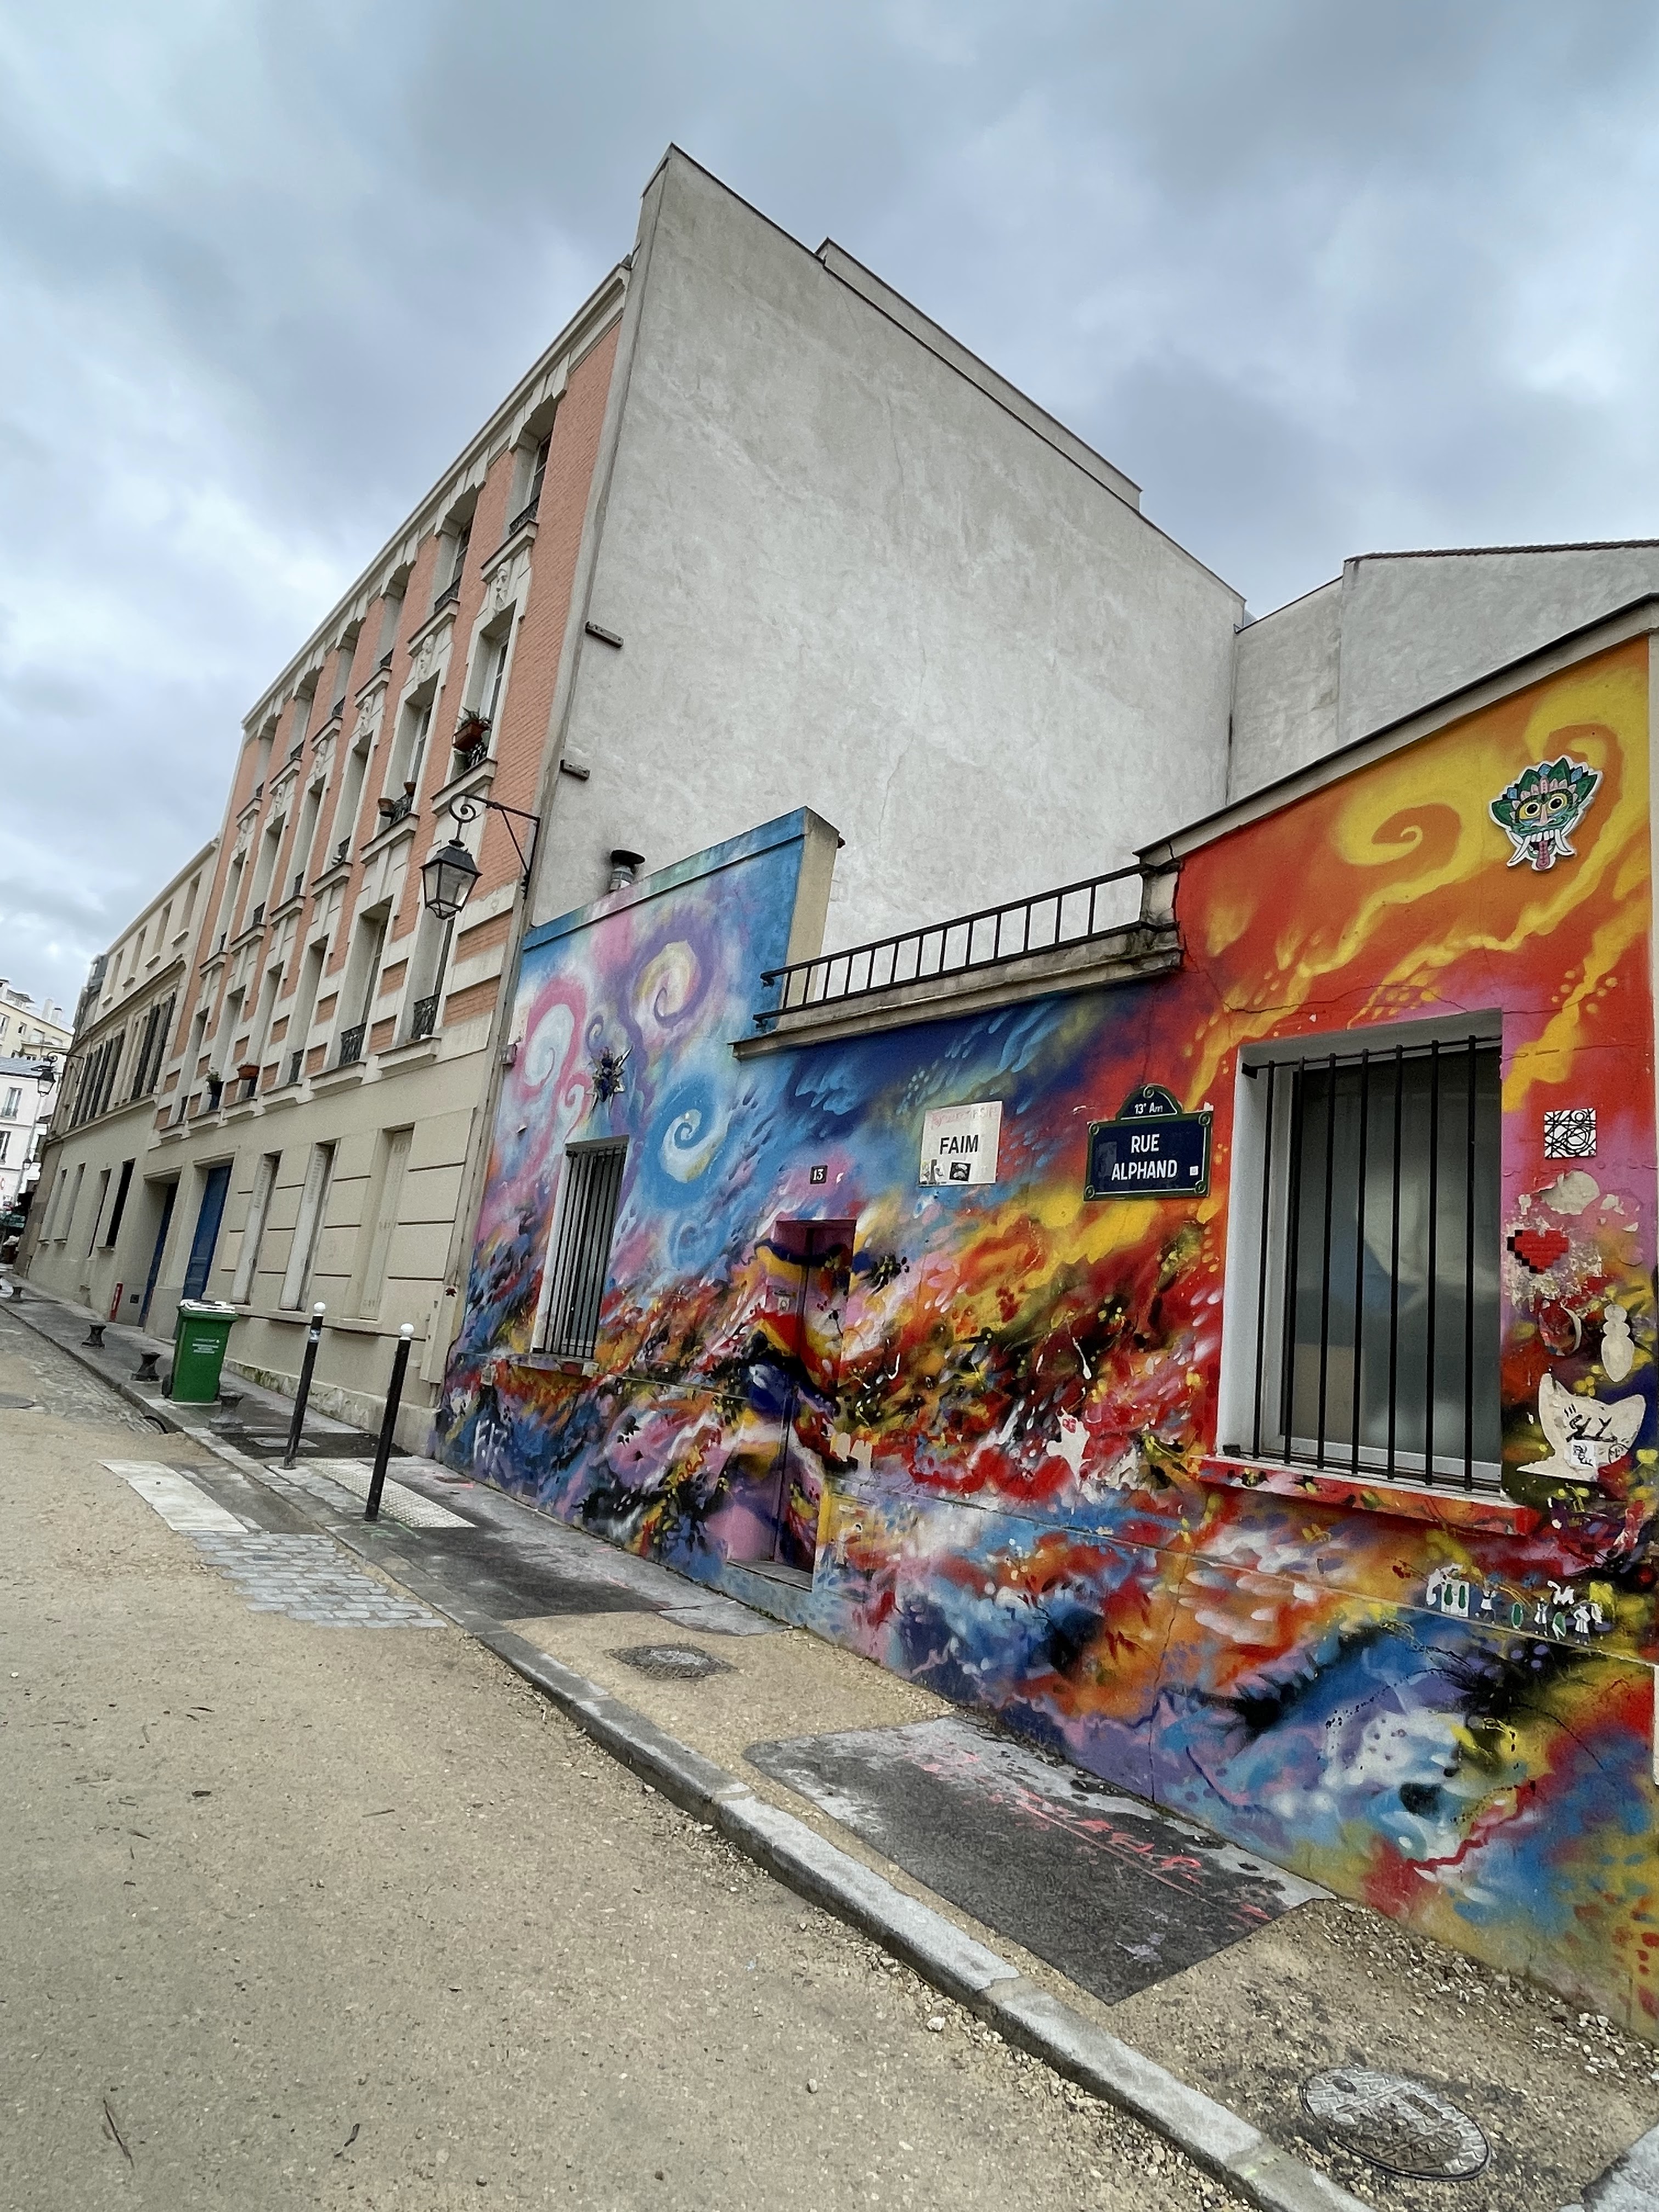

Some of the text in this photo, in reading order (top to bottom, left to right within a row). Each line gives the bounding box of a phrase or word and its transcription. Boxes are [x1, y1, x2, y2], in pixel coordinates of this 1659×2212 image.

[940, 1135, 978, 1155] FAIM
[1131, 1134, 1160, 1153] RUE
[812, 1169, 824, 1181] 13
[1111, 1160, 1177, 1180] ALPHAND
